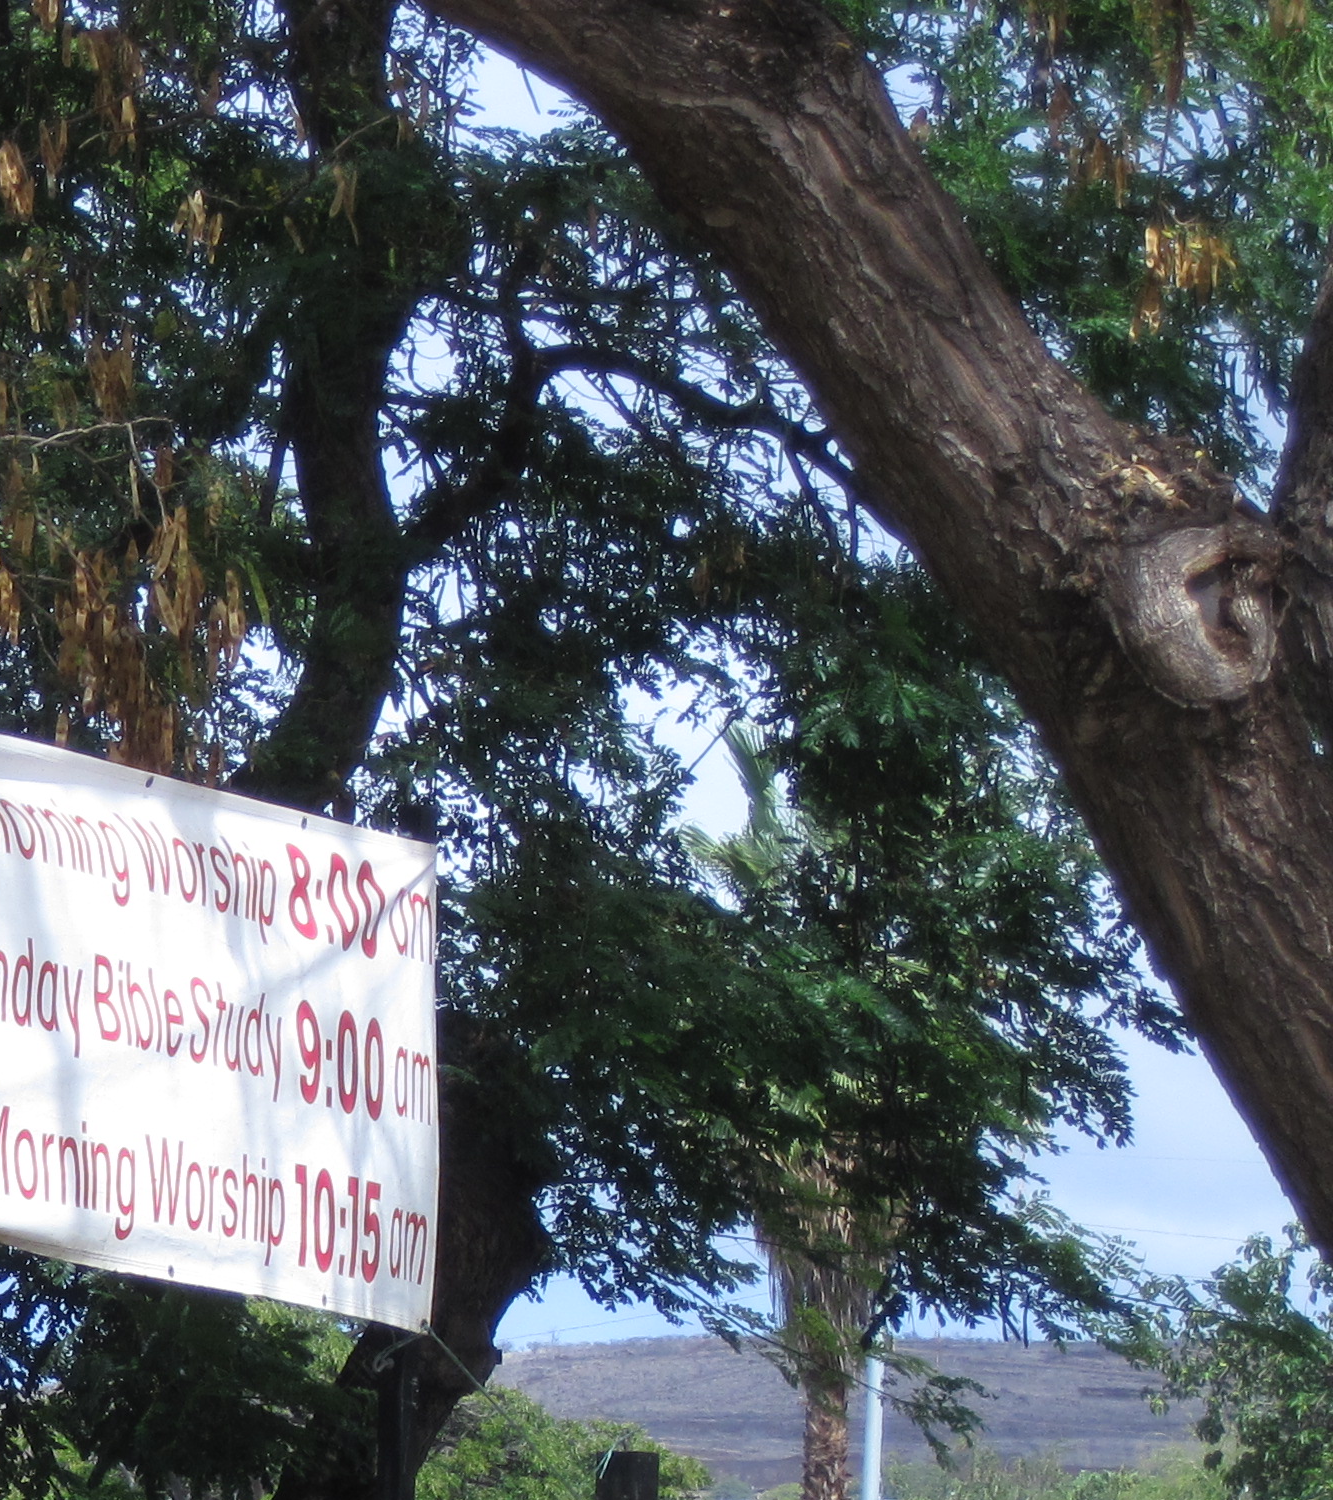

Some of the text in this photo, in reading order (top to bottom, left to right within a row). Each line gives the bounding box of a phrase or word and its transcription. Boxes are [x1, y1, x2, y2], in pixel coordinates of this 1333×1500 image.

[114, 811, 278, 945] Worship
[285, 843, 384, 960] 8:00
[388, 886, 434, 966] am
[93, 953, 185, 1056] Bible
[189, 976, 283, 1103] Study
[296, 999, 385, 1122] 9:00
[393, 1045, 433, 1127] am
[145, 1134, 285, 1267] Worship
[294, 1164, 382, 1285] 10:15
[389, 1207, 429, 1286] am
